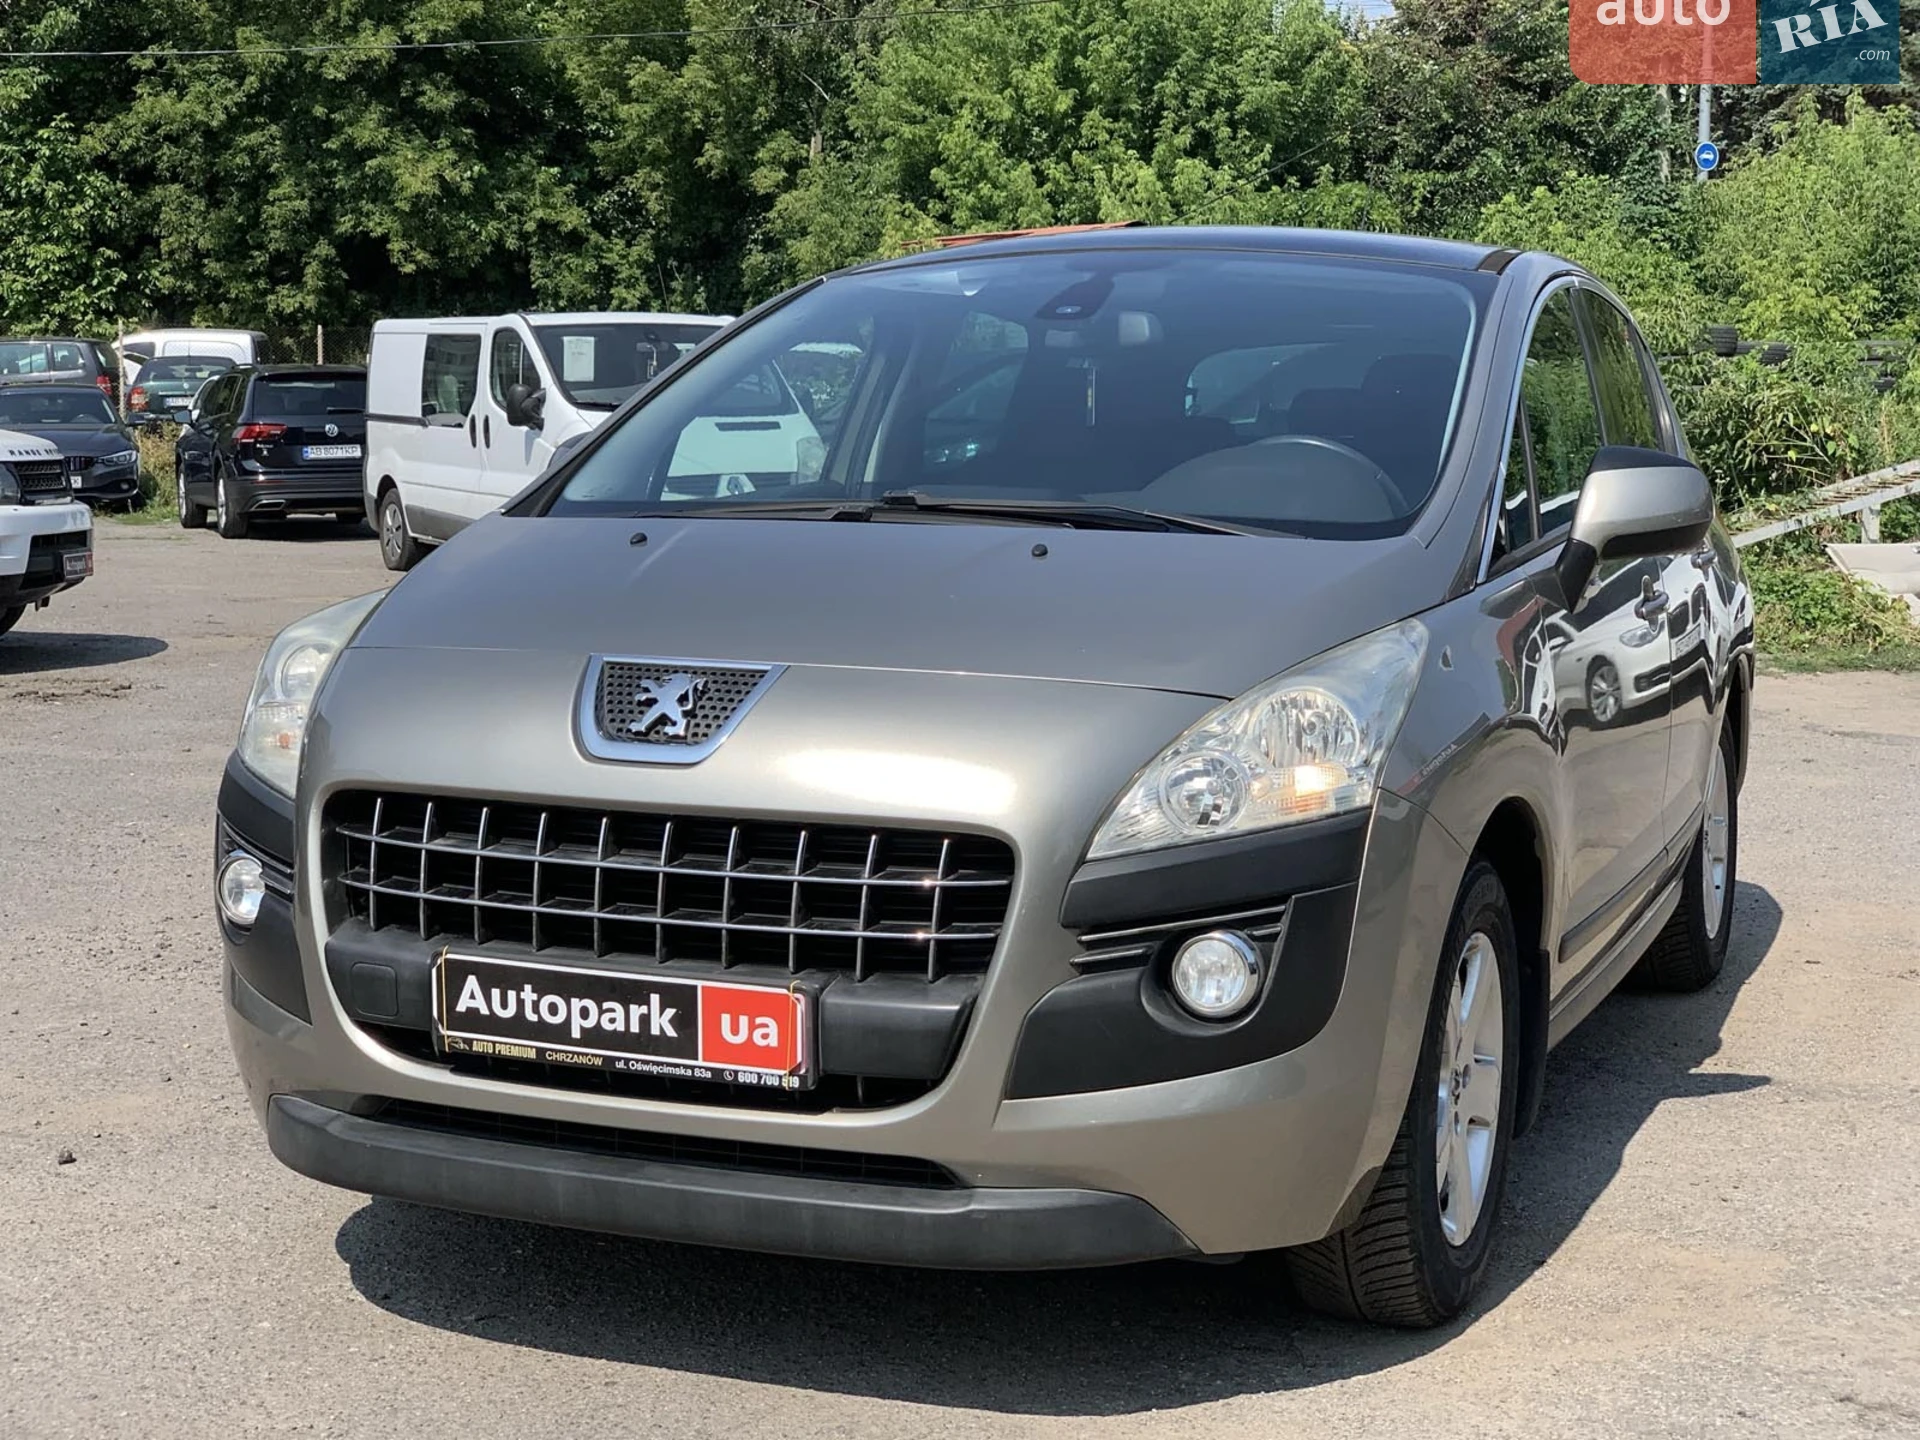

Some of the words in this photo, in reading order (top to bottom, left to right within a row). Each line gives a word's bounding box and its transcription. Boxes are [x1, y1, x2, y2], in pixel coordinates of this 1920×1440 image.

[455, 974, 678, 1039] Autopark
[720, 1012, 779, 1047] ua
[472, 1040, 494, 1054] AUTO
[495, 1043, 537, 1059] PREMIUM
[545, 1051, 603, 1066] CHRZANÓW
[615, 1060, 627, 1069] ul.
[629, 1061, 692, 1077] Oświęcimska
[694, 1069, 712, 1079] 83a
[738, 1073, 758, 1084] 600
[760, 1074, 780, 1086] 700
